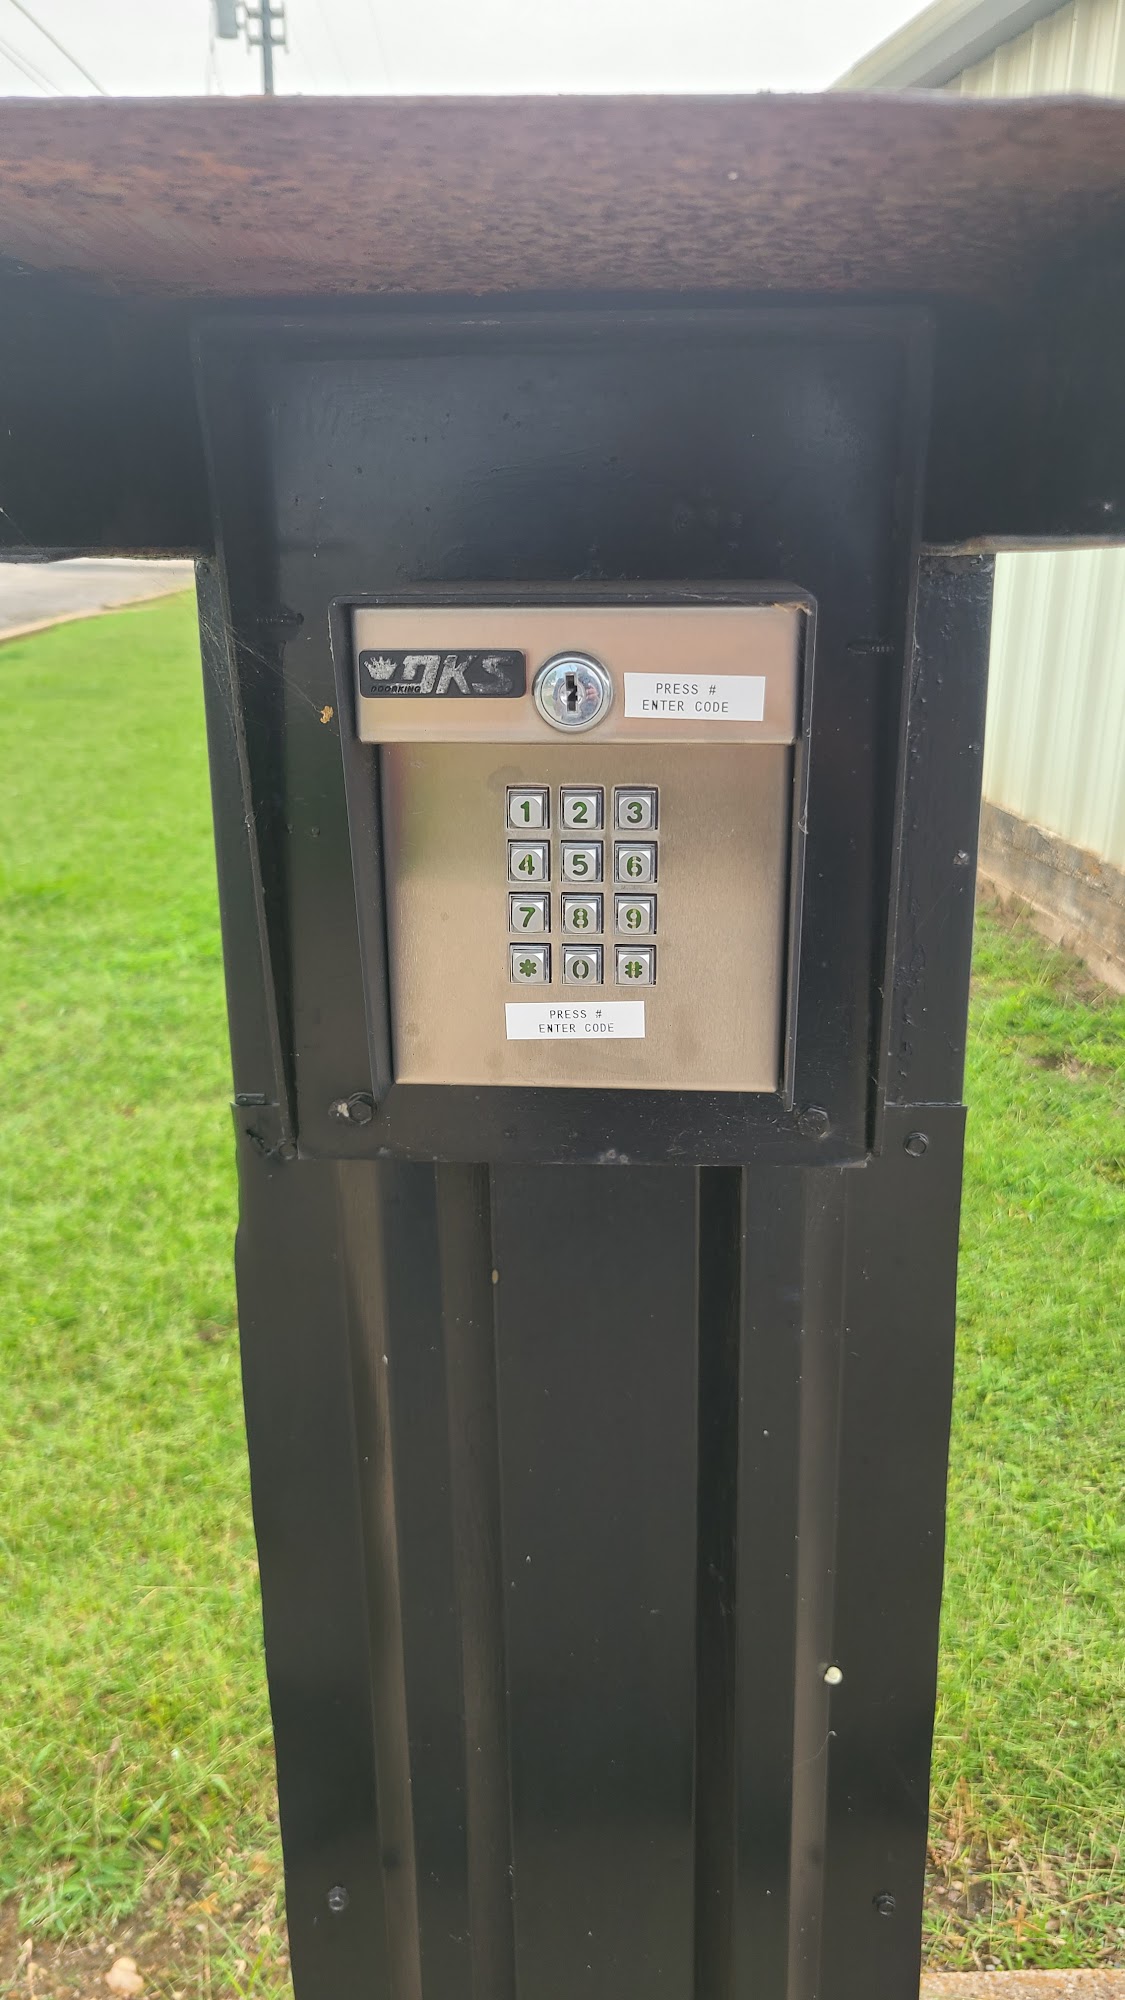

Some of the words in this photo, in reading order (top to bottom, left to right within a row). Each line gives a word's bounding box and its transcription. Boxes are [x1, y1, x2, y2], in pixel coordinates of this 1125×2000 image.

[370, 685, 421, 694] DOORKING
[655, 682, 699, 695] PRESS
[708, 684, 717, 695] #
[642, 699, 685, 711] ENTER
[695, 701, 729, 713] CODE
[520, 800, 530, 823] 1
[572, 801, 588, 824] 2
[626, 801, 643, 824] 3
[518, 853, 535, 876] 4
[572, 854, 589, 876] 5
[626, 855, 643, 878] 6
[519, 906, 536, 928] 7
[572, 907, 589, 929] 8
[625, 908, 642, 929] 9
[572, 959, 590, 979] 0
[549, 1009, 588, 1019] PRESS
[595, 1009, 602, 1019] #
[538, 1023, 576, 1033] ENTER
[584, 1022, 615, 1033] CODE
